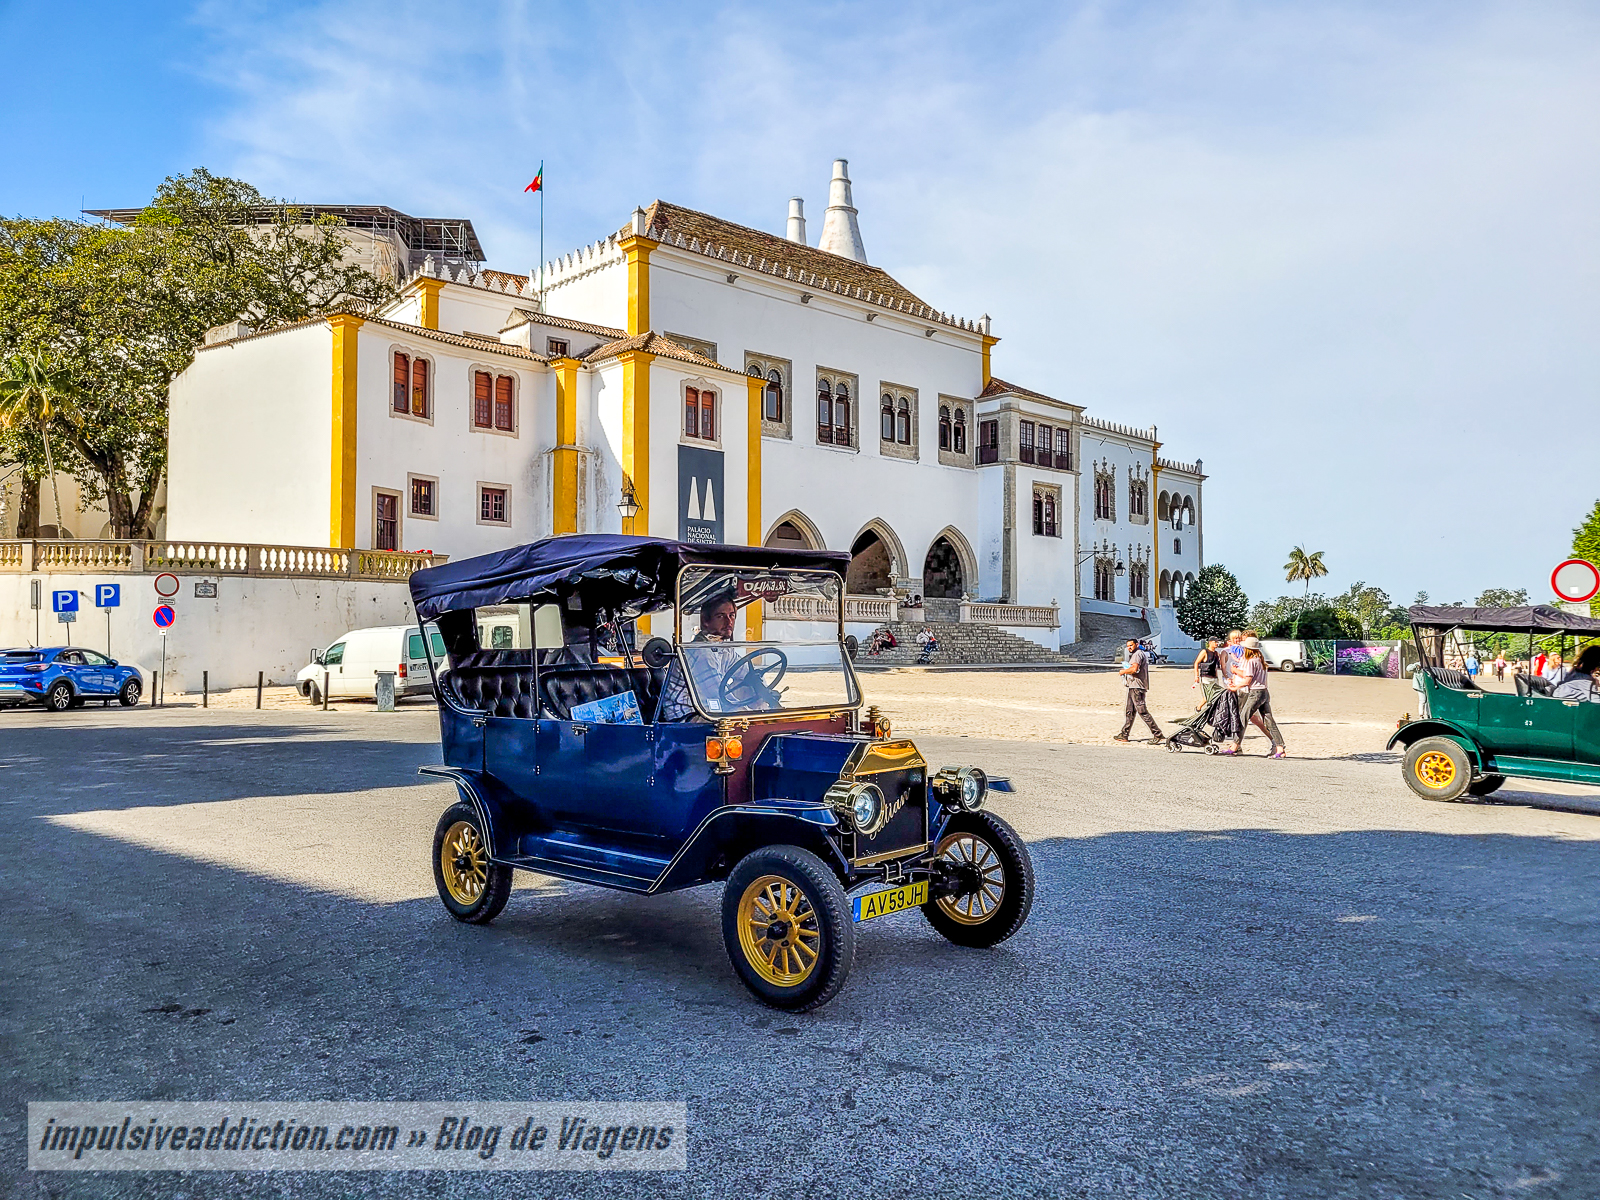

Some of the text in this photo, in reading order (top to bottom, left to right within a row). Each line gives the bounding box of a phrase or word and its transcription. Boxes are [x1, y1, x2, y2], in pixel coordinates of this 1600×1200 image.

[687, 525, 711, 534] PALÁCIO
[687, 531, 717, 541] NACIONAL
[57, 592, 74, 611] P
[101, 586, 116, 606] P
